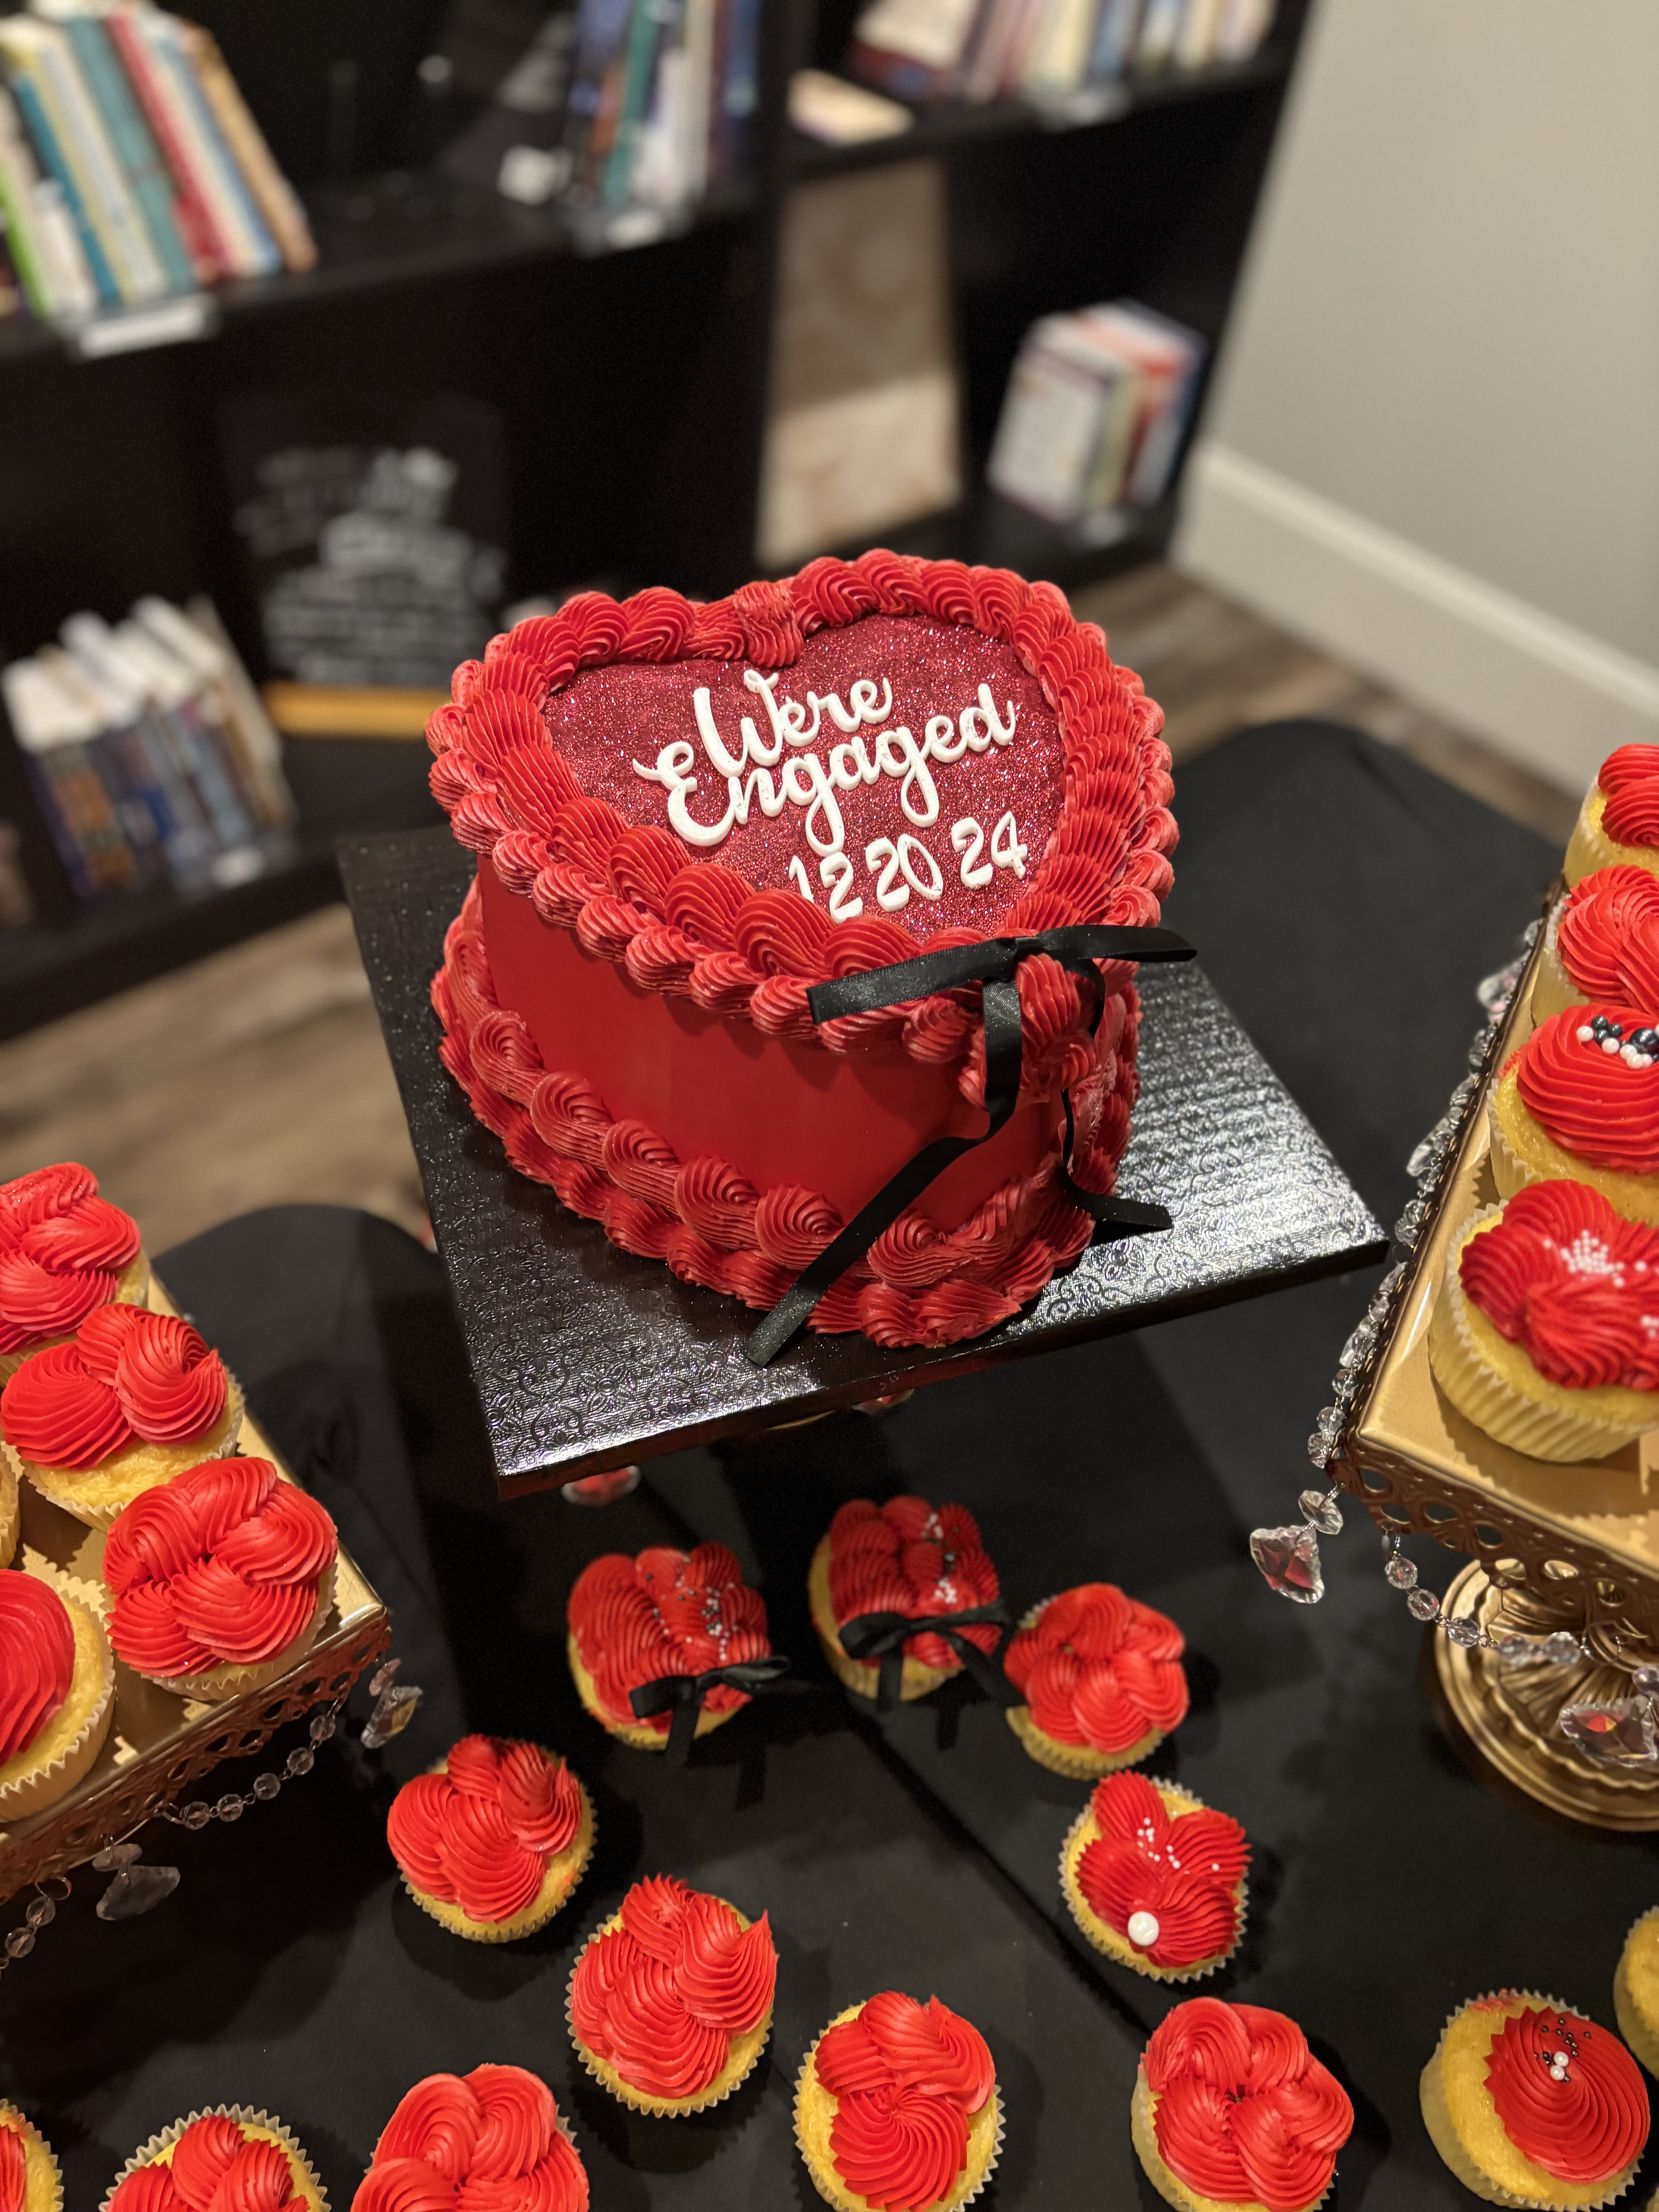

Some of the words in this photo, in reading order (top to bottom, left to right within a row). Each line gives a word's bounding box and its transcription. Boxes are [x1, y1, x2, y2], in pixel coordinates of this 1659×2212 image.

[632, 683, 1016, 857] Engaged
[789, 852, 863, 924] 12
[865, 834, 943, 912] 20
[951, 811, 1028, 890] 24
